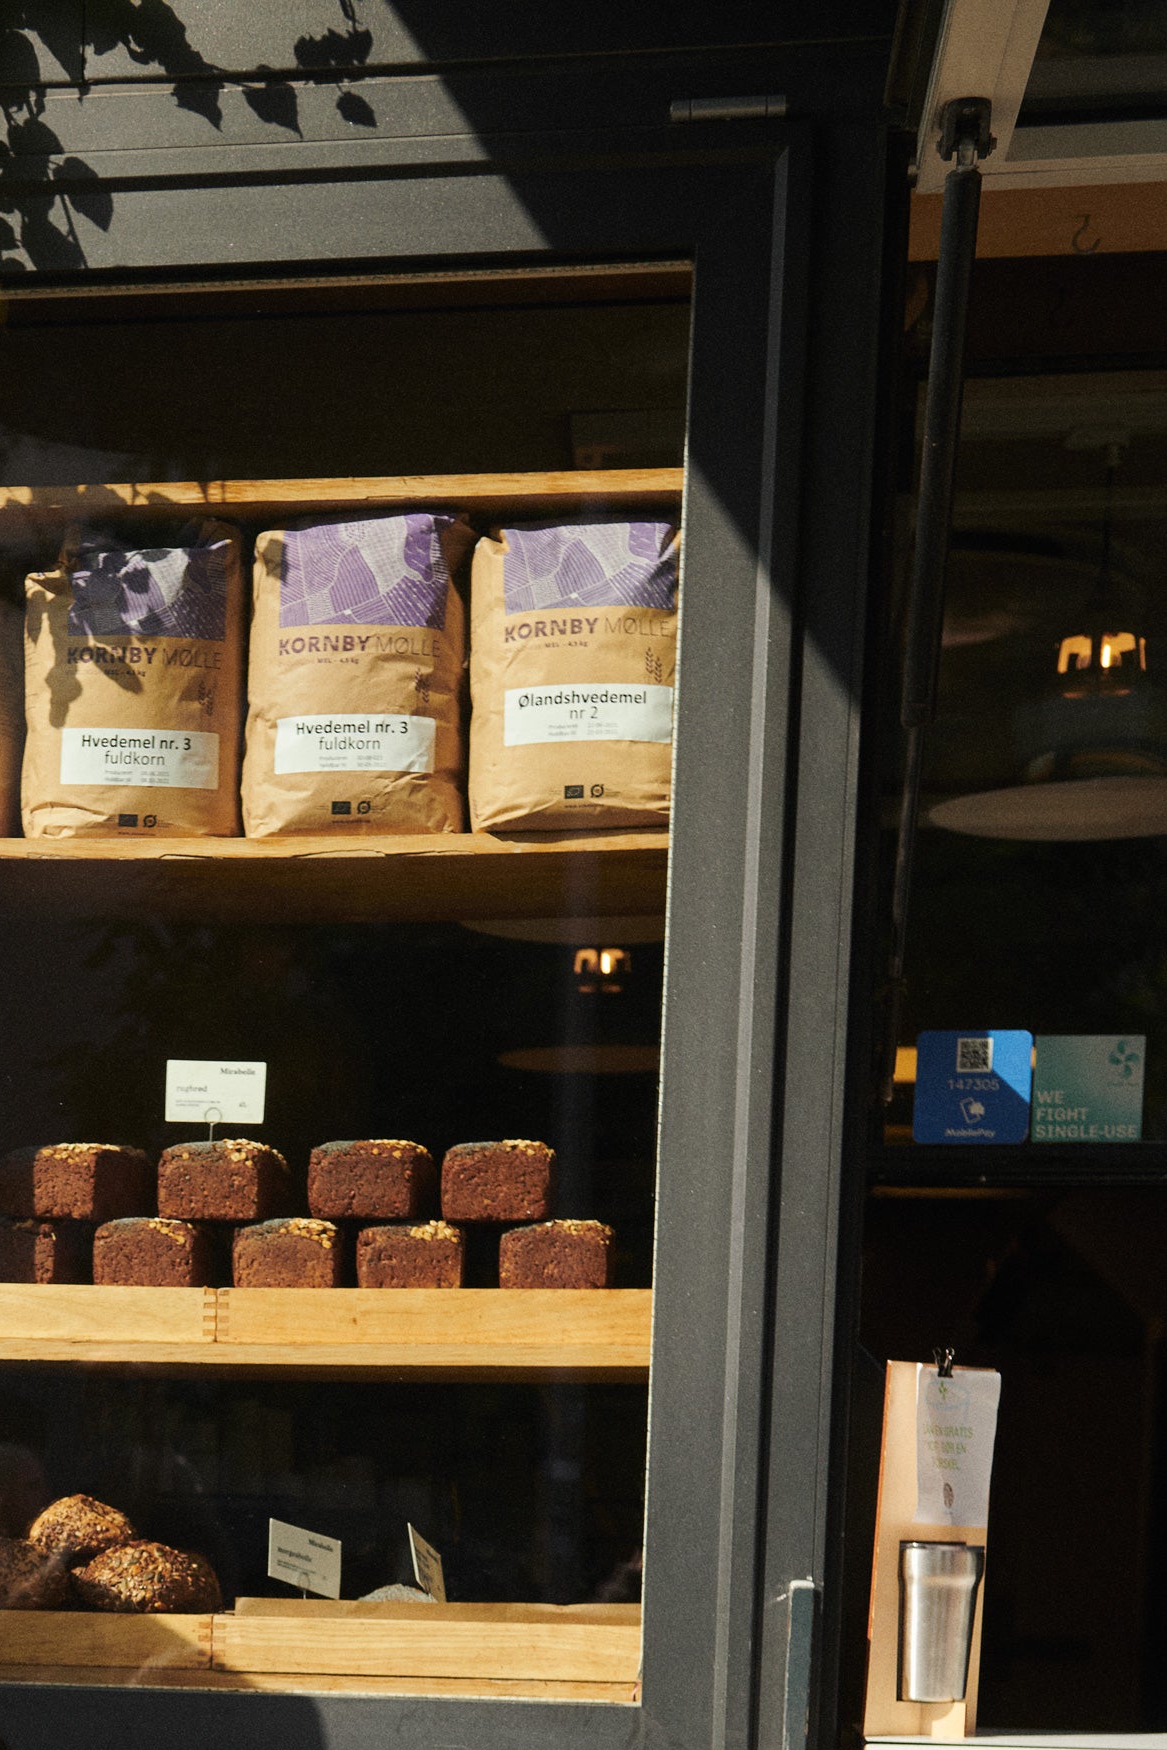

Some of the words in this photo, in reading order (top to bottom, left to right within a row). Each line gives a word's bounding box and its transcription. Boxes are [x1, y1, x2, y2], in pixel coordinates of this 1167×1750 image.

[504, 617, 598, 643] KORNBY
[604, 616, 670, 637] MØLLE
[279, 635, 370, 656] KORNBY
[376, 636, 441, 658] MØLLE
[67, 646, 157, 665] KORNBY
[162, 648, 221, 670] MØLLE
[518, 690, 647, 709] Ølandshvedemel
[570, 711, 584, 720] nr
[590, 706, 598, 719] 2
[296, 720, 370, 735] Hvedemel
[375, 722, 395, 734] nr.
[401, 721, 409, 734] 3
[82, 734, 155, 749] Hvedemel
[160, 738, 179, 750] nr.
[184, 738, 192, 750] 3
[318, 736, 381, 750] fuldkorn
[105, 750, 165, 766] fuldkorn
[1036, 1090, 1064, 1104] WE
[1036, 1107, 1089, 1121] FIGHT
[945, 1127, 995, 1139] MobilePay
[1035, 1124, 1138, 1139] SINGLE-USE
